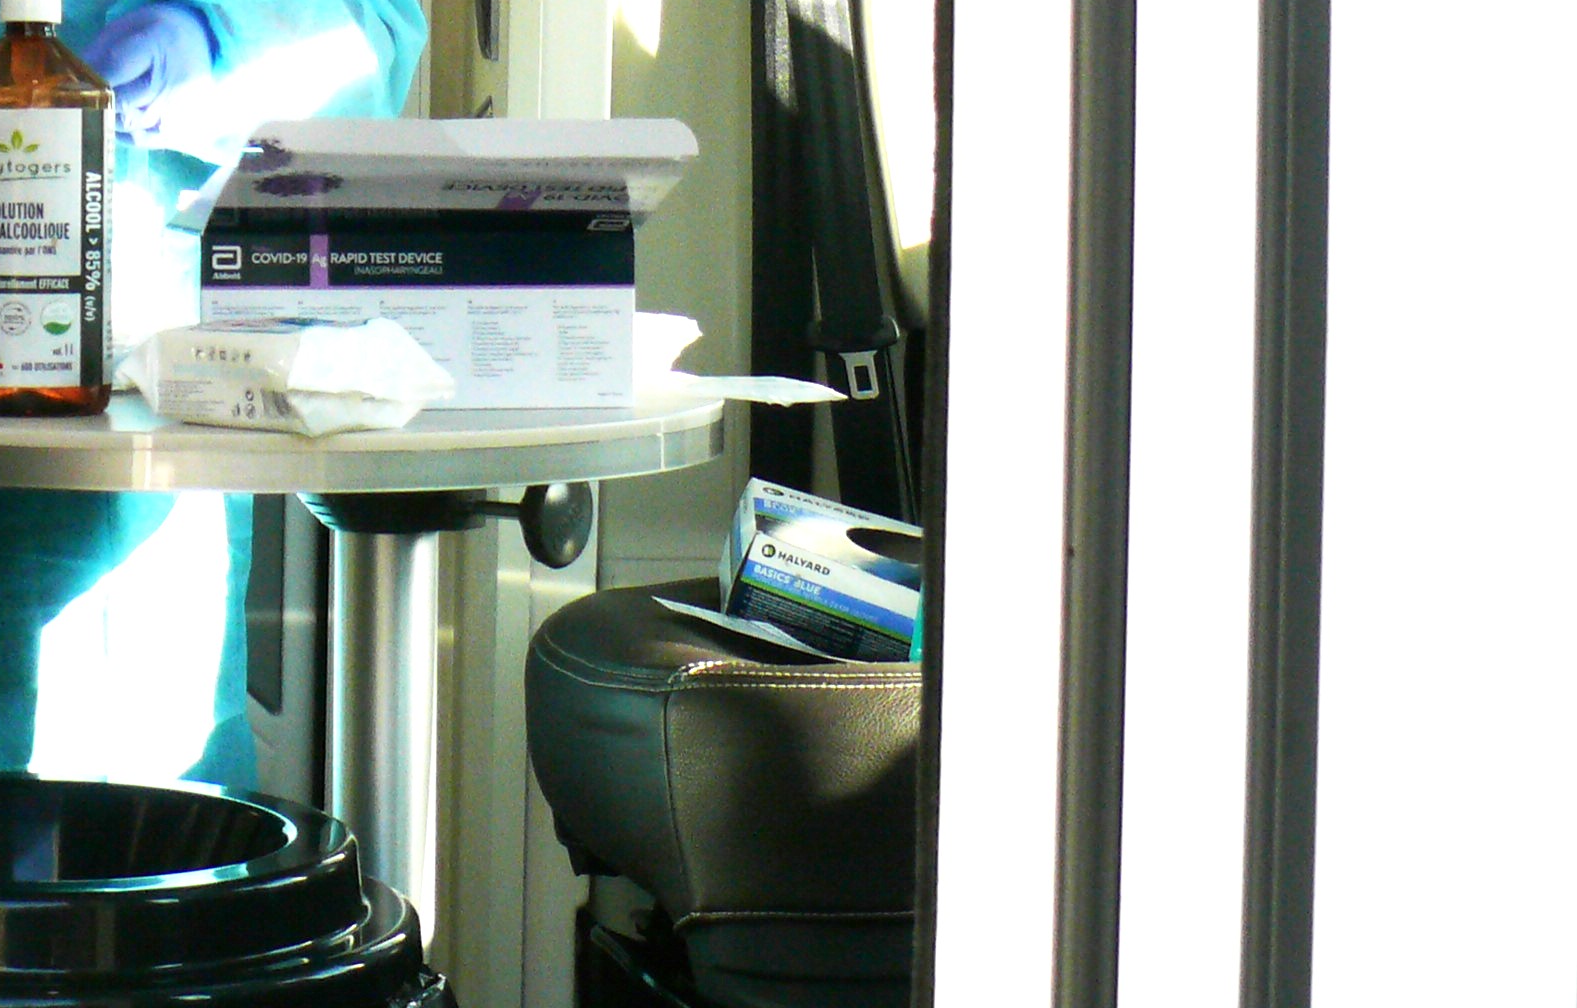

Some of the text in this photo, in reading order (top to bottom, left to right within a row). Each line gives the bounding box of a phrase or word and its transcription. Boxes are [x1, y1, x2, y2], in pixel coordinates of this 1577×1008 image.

[85, 171, 102, 233] ALCOOL
[251, 252, 308, 264] COVID-19
[330, 252, 368, 264] RAPID
[369, 252, 397, 264] TEST
[398, 252, 443, 264] DEVICE
[85, 250, 101, 291] 85%
[38, 278, 70, 290] EFFICACE
[752, 564, 791, 585] BASICS
[777, 550, 831, 576] HALYARD
